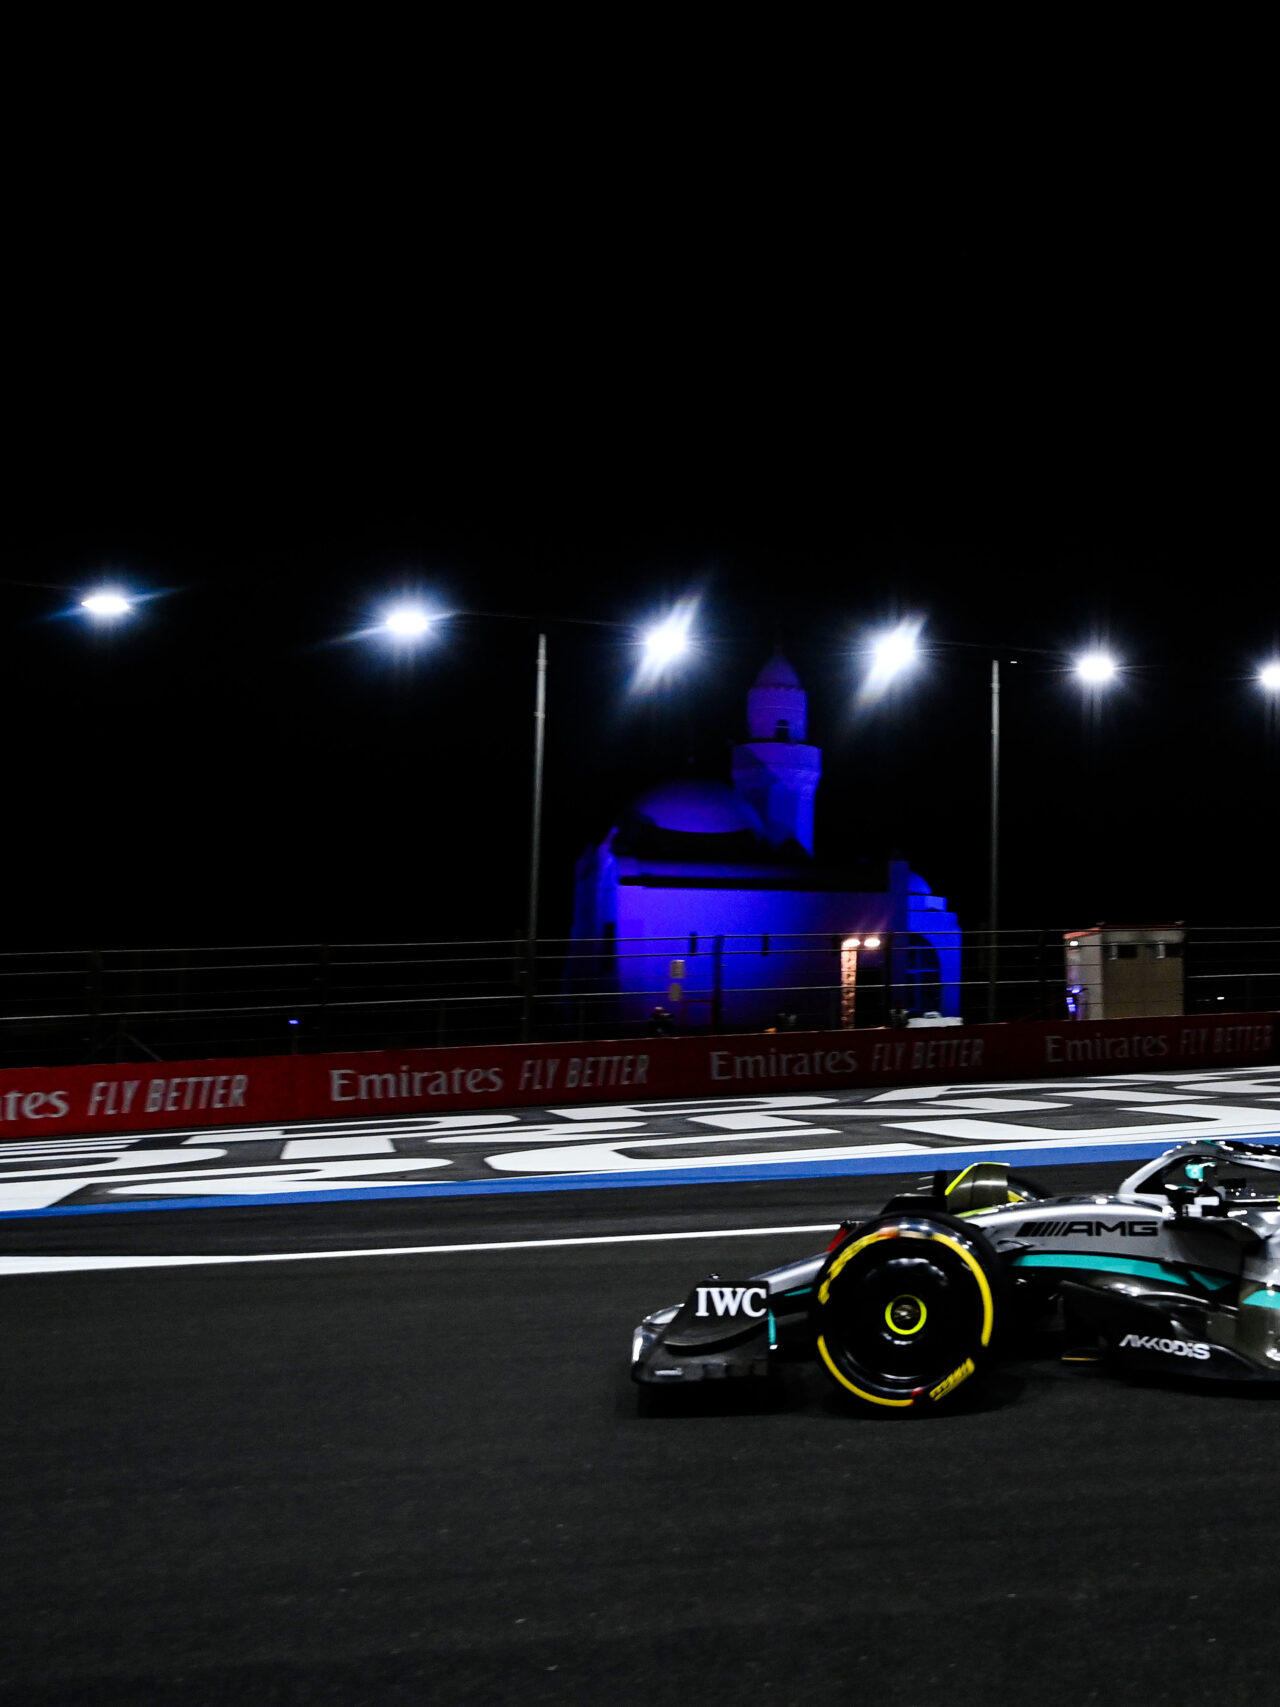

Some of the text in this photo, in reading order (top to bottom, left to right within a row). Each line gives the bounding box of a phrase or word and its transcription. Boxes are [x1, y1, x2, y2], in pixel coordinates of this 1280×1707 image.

[708, 1038, 985, 1081] Emirates FLY BETTER
[1044, 1024, 1274, 1063] Emirates FLY BETTER
[0, 1074, 250, 1121] tes FLY BETTER
[328, 1054, 650, 1102] Emirates FLY BETTER
[1061, 1220, 1159, 1237] AMG
[694, 1286, 769, 1318] IWC
